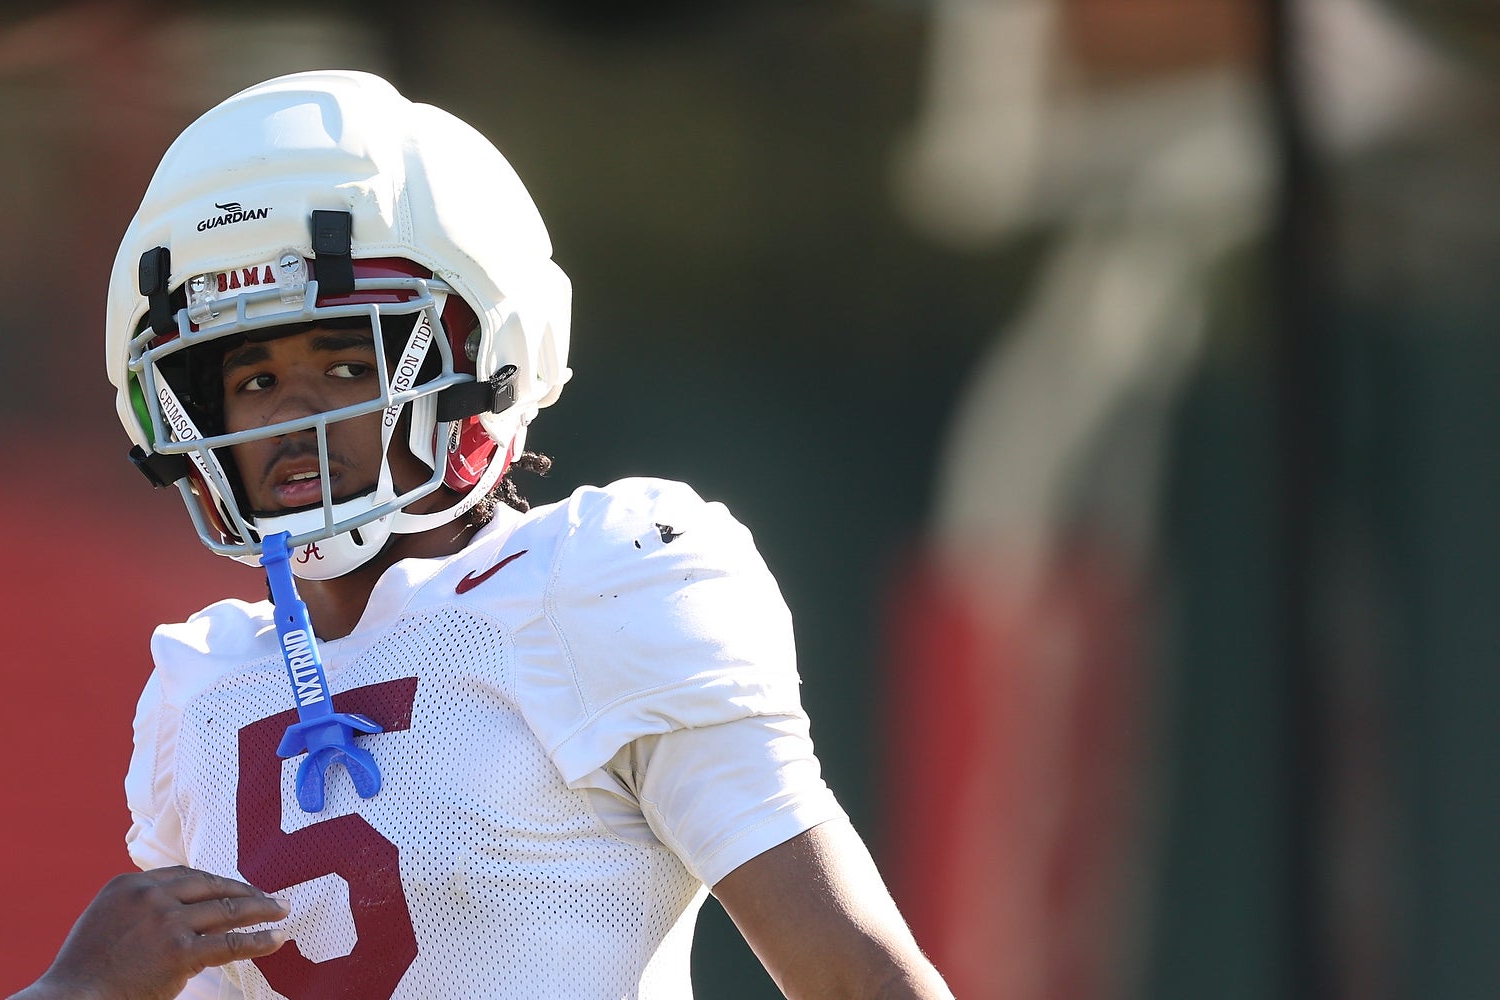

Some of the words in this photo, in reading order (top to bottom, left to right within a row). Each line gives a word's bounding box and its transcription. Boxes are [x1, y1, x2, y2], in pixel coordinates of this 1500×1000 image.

[197, 207, 268, 232] GUARDIAN
[217, 265, 276, 292] BAMA
[283, 629, 325, 707] NXTRND
